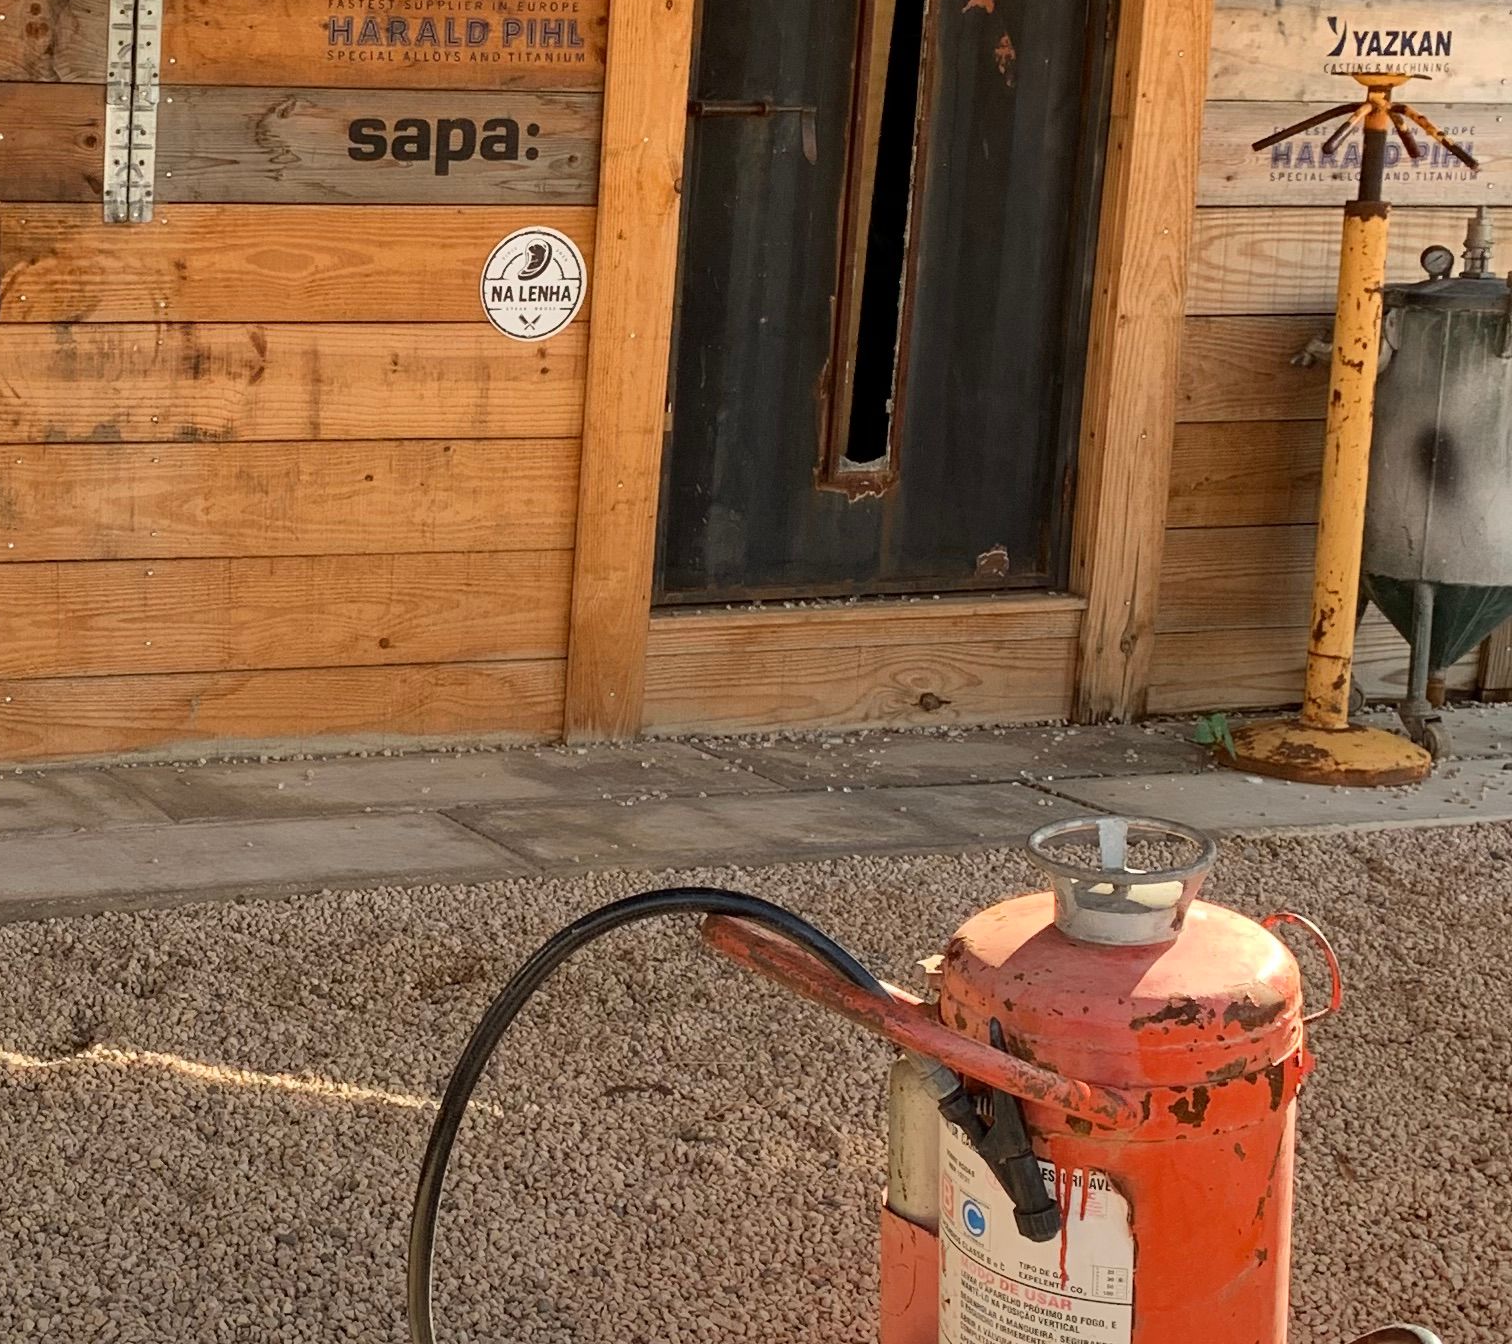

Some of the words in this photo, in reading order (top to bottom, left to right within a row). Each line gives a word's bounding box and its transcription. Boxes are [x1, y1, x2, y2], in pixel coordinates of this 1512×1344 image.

[328, 0, 394, 12] FASTEST
[405, 0, 483, 12] SUPPLIER
[492, 1, 508, 12] IN
[517, 1, 579, 14] EUROPE
[327, 15, 489, 47] HARALD
[502, 18, 585, 49] PIHL
[1353, 30, 1452, 57] YAZKAN
[327, 50, 394, 62] SPECIAL
[402, 51, 462, 63] ALLOYS
[469, 51, 501, 63] AND
[508, 52, 585, 64] TITANIUM
[1324, 62, 1371, 74] CASTING
[1385, 63, 1449, 74] MACHINING
[348, 117, 540, 176] sapa:
[1271, 141, 1401, 169] HARAD
[1269, 171, 1325, 182] SPECIAL
[1385, 172, 1409, 181] AND
[1416, 171, 1477, 182] TITANIUM
[491, 286, 514, 303] NA
[519, 286, 571, 303] LENHA
[1019, 1262, 1037, 1273] TIPO
[1039, 1267, 1049, 1276] DE
[961, 1255, 994, 1284] MODO
[999, 1277, 1019, 1295] DE
[1024, 1288, 1072, 1311] USAR
[1019, 1272, 1065, 1289] EXPELENT
[985, 1286, 1021, 1307] APARELHO
[1065, 1314, 1078, 1323] AO
[1111, 1321, 1117, 1329] E
[991, 1298, 1001, 1308] NA
[1038, 1316, 1080, 1334] VERTICAL
